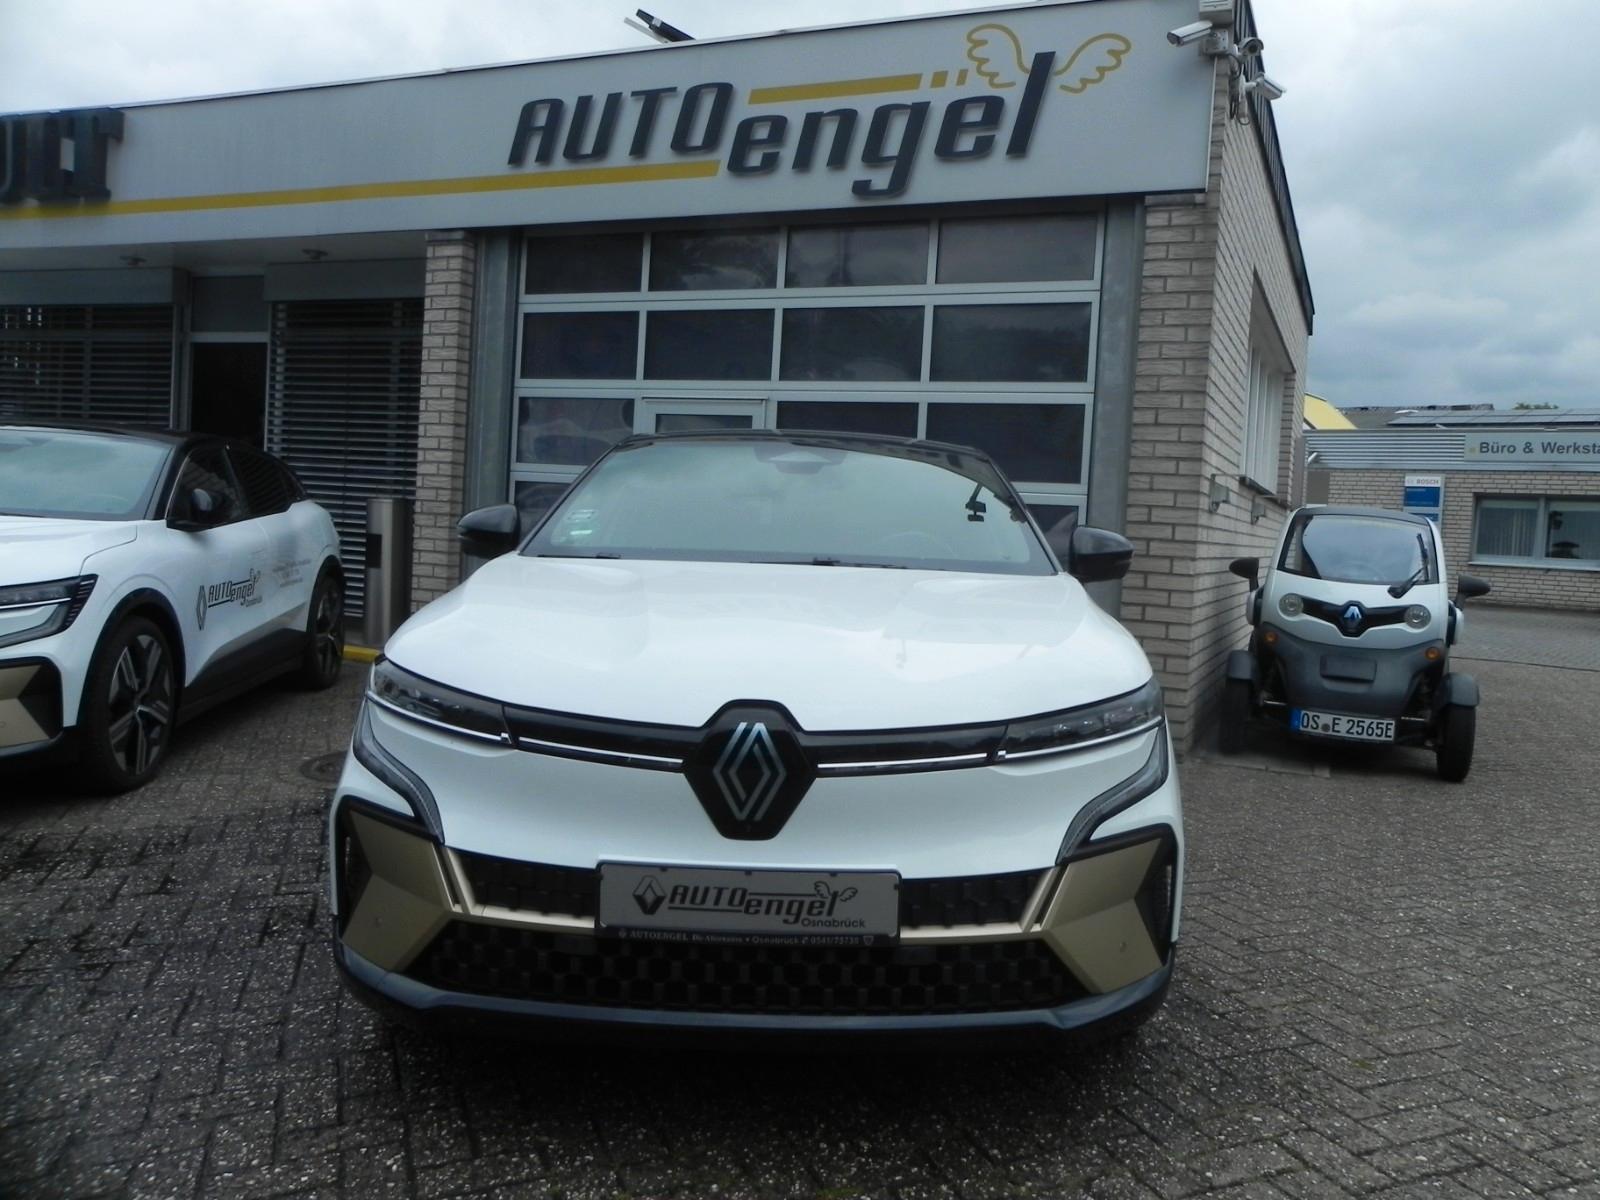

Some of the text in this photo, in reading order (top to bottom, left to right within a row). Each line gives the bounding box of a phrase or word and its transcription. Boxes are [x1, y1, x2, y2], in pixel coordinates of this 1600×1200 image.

[507, 51, 1057, 198] AUTOengel
[1479, 441, 1517, 455] Büro
[1523, 441, 1534, 455] &
[1301, 712, 1394, 739] OS E 2565E
[668, 884, 841, 925] AUTOengel
[801, 917, 867, 928] Osnabrück
